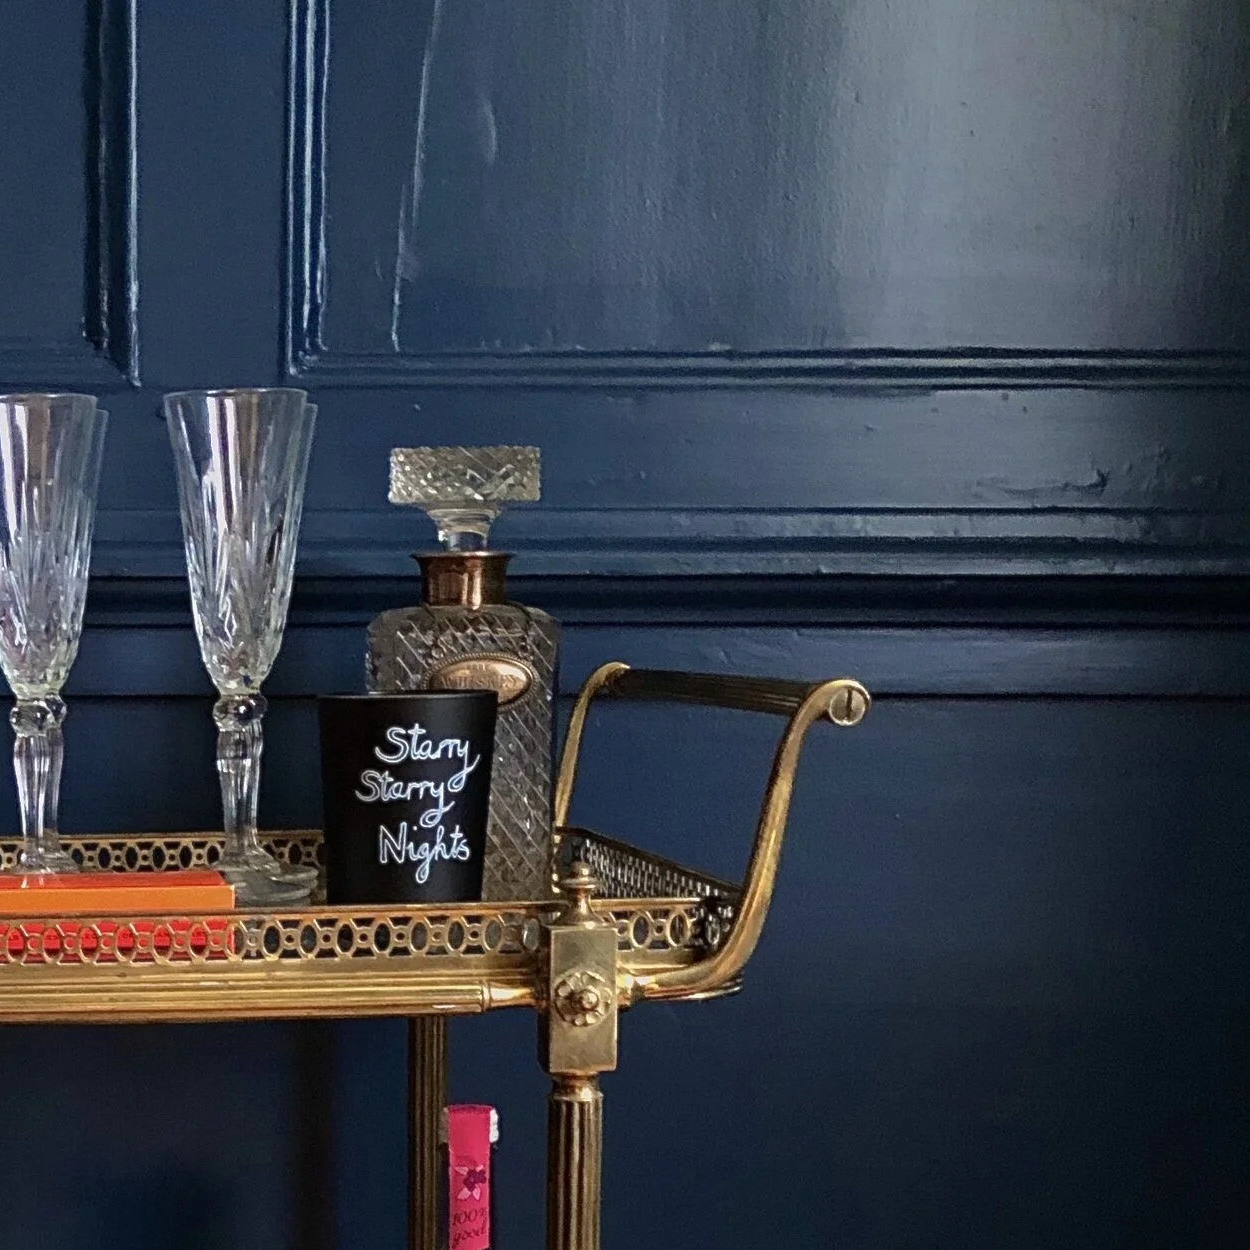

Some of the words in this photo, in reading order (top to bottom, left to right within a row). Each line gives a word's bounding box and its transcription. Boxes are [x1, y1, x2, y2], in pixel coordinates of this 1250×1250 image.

[374, 723, 481, 792] Starry
[355, 769, 456, 828] Starry
[379, 821, 471, 884] Nights
